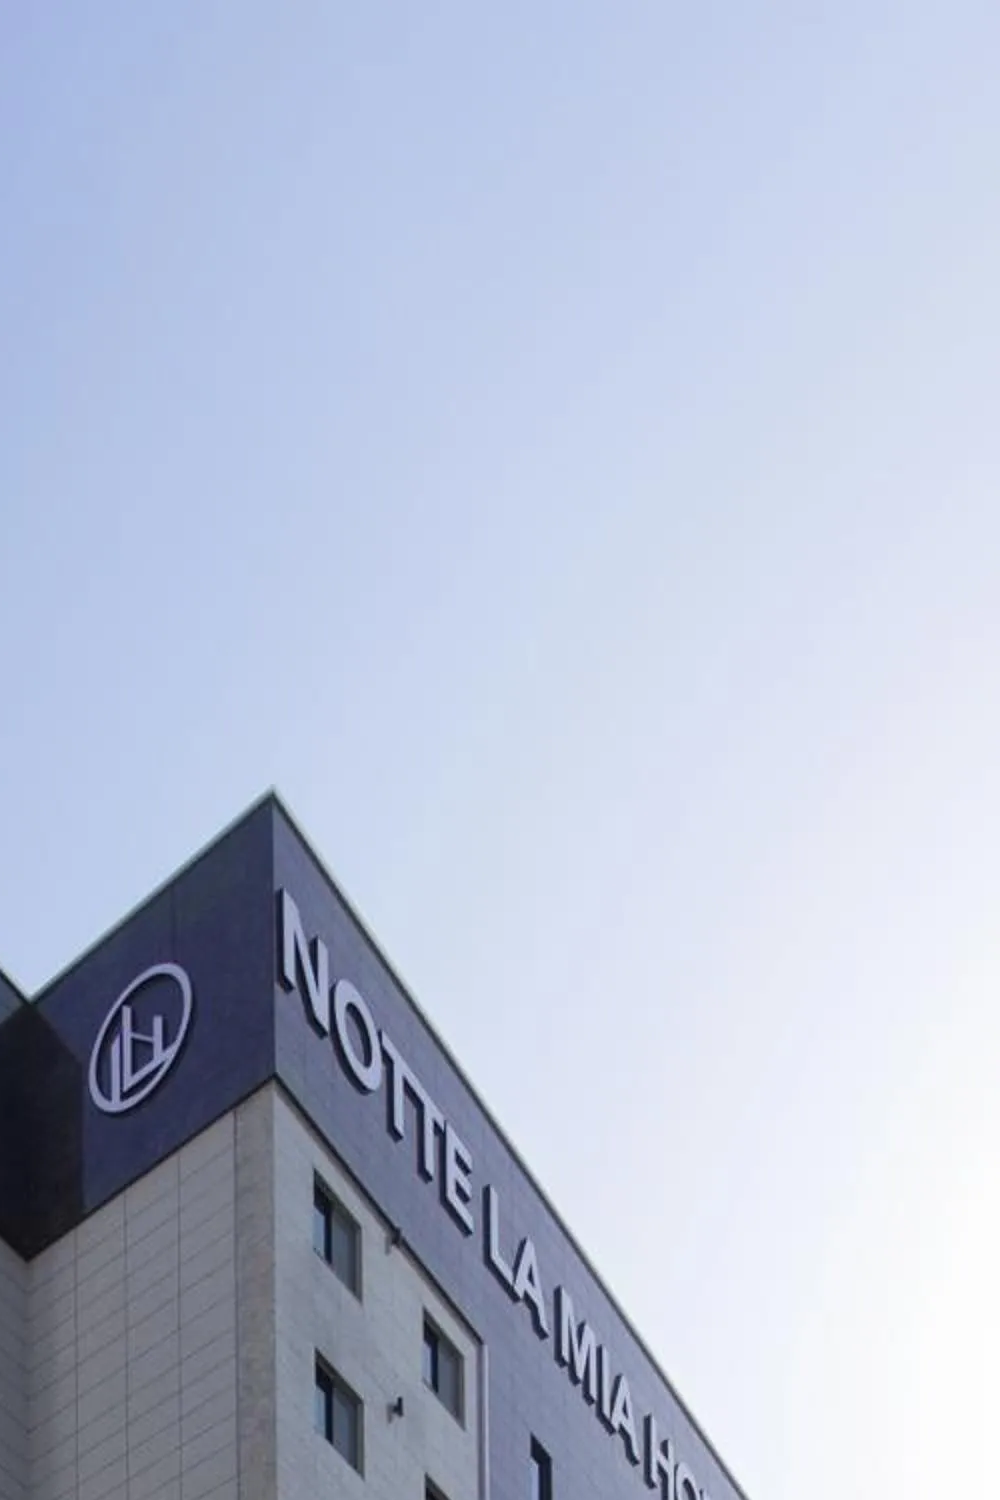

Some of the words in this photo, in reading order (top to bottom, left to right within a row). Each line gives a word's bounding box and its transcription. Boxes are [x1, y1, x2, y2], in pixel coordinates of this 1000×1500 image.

[278, 887, 473, 1236] NOTTE
[482, 1184, 549, 1340] LA
[554, 1285, 640, 1466] MIA
